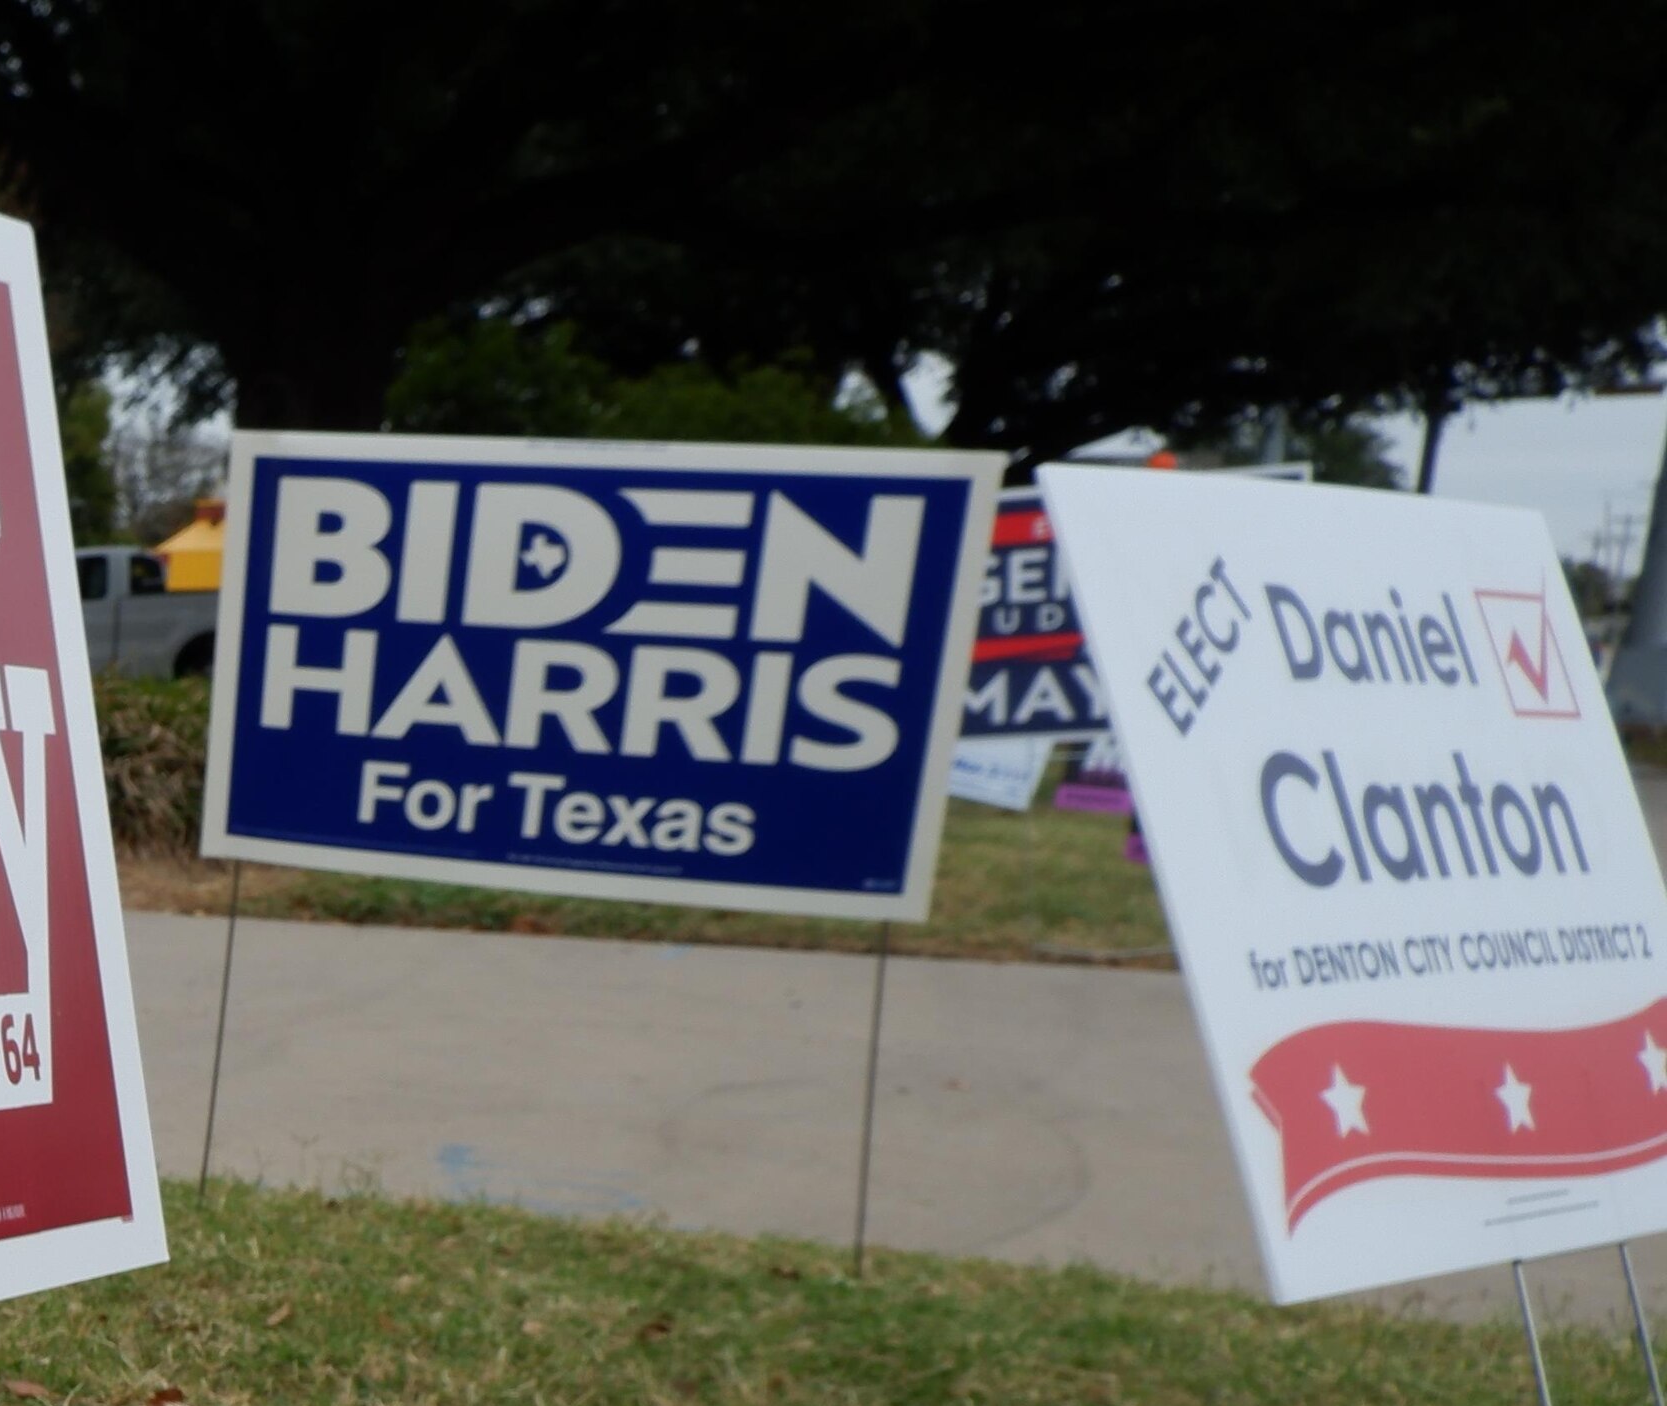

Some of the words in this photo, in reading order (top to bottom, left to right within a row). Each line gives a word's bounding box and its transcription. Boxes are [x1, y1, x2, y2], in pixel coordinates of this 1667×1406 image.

[269, 475, 926, 649] BIDEN
[1146, 555, 1252, 736] ELECT
[1264, 582, 1479, 687] Daniel
[260, 624, 902, 773] HARRIS
[357, 760, 493, 834] For
[507, 771, 757, 857] Texas
[1260, 750, 1590, 887] Clanton
[1249, 950, 1289, 991] for
[1293, 941, 1400, 986] DENTON
[1404, 935, 1454, 975] CITY
[1460, 928, 1558, 970] COUNCIL
[1557, 923, 1635, 964] DISTRICT
[1635, 924, 1653, 959] 2
[0, 1013, 41, 1085] 64
